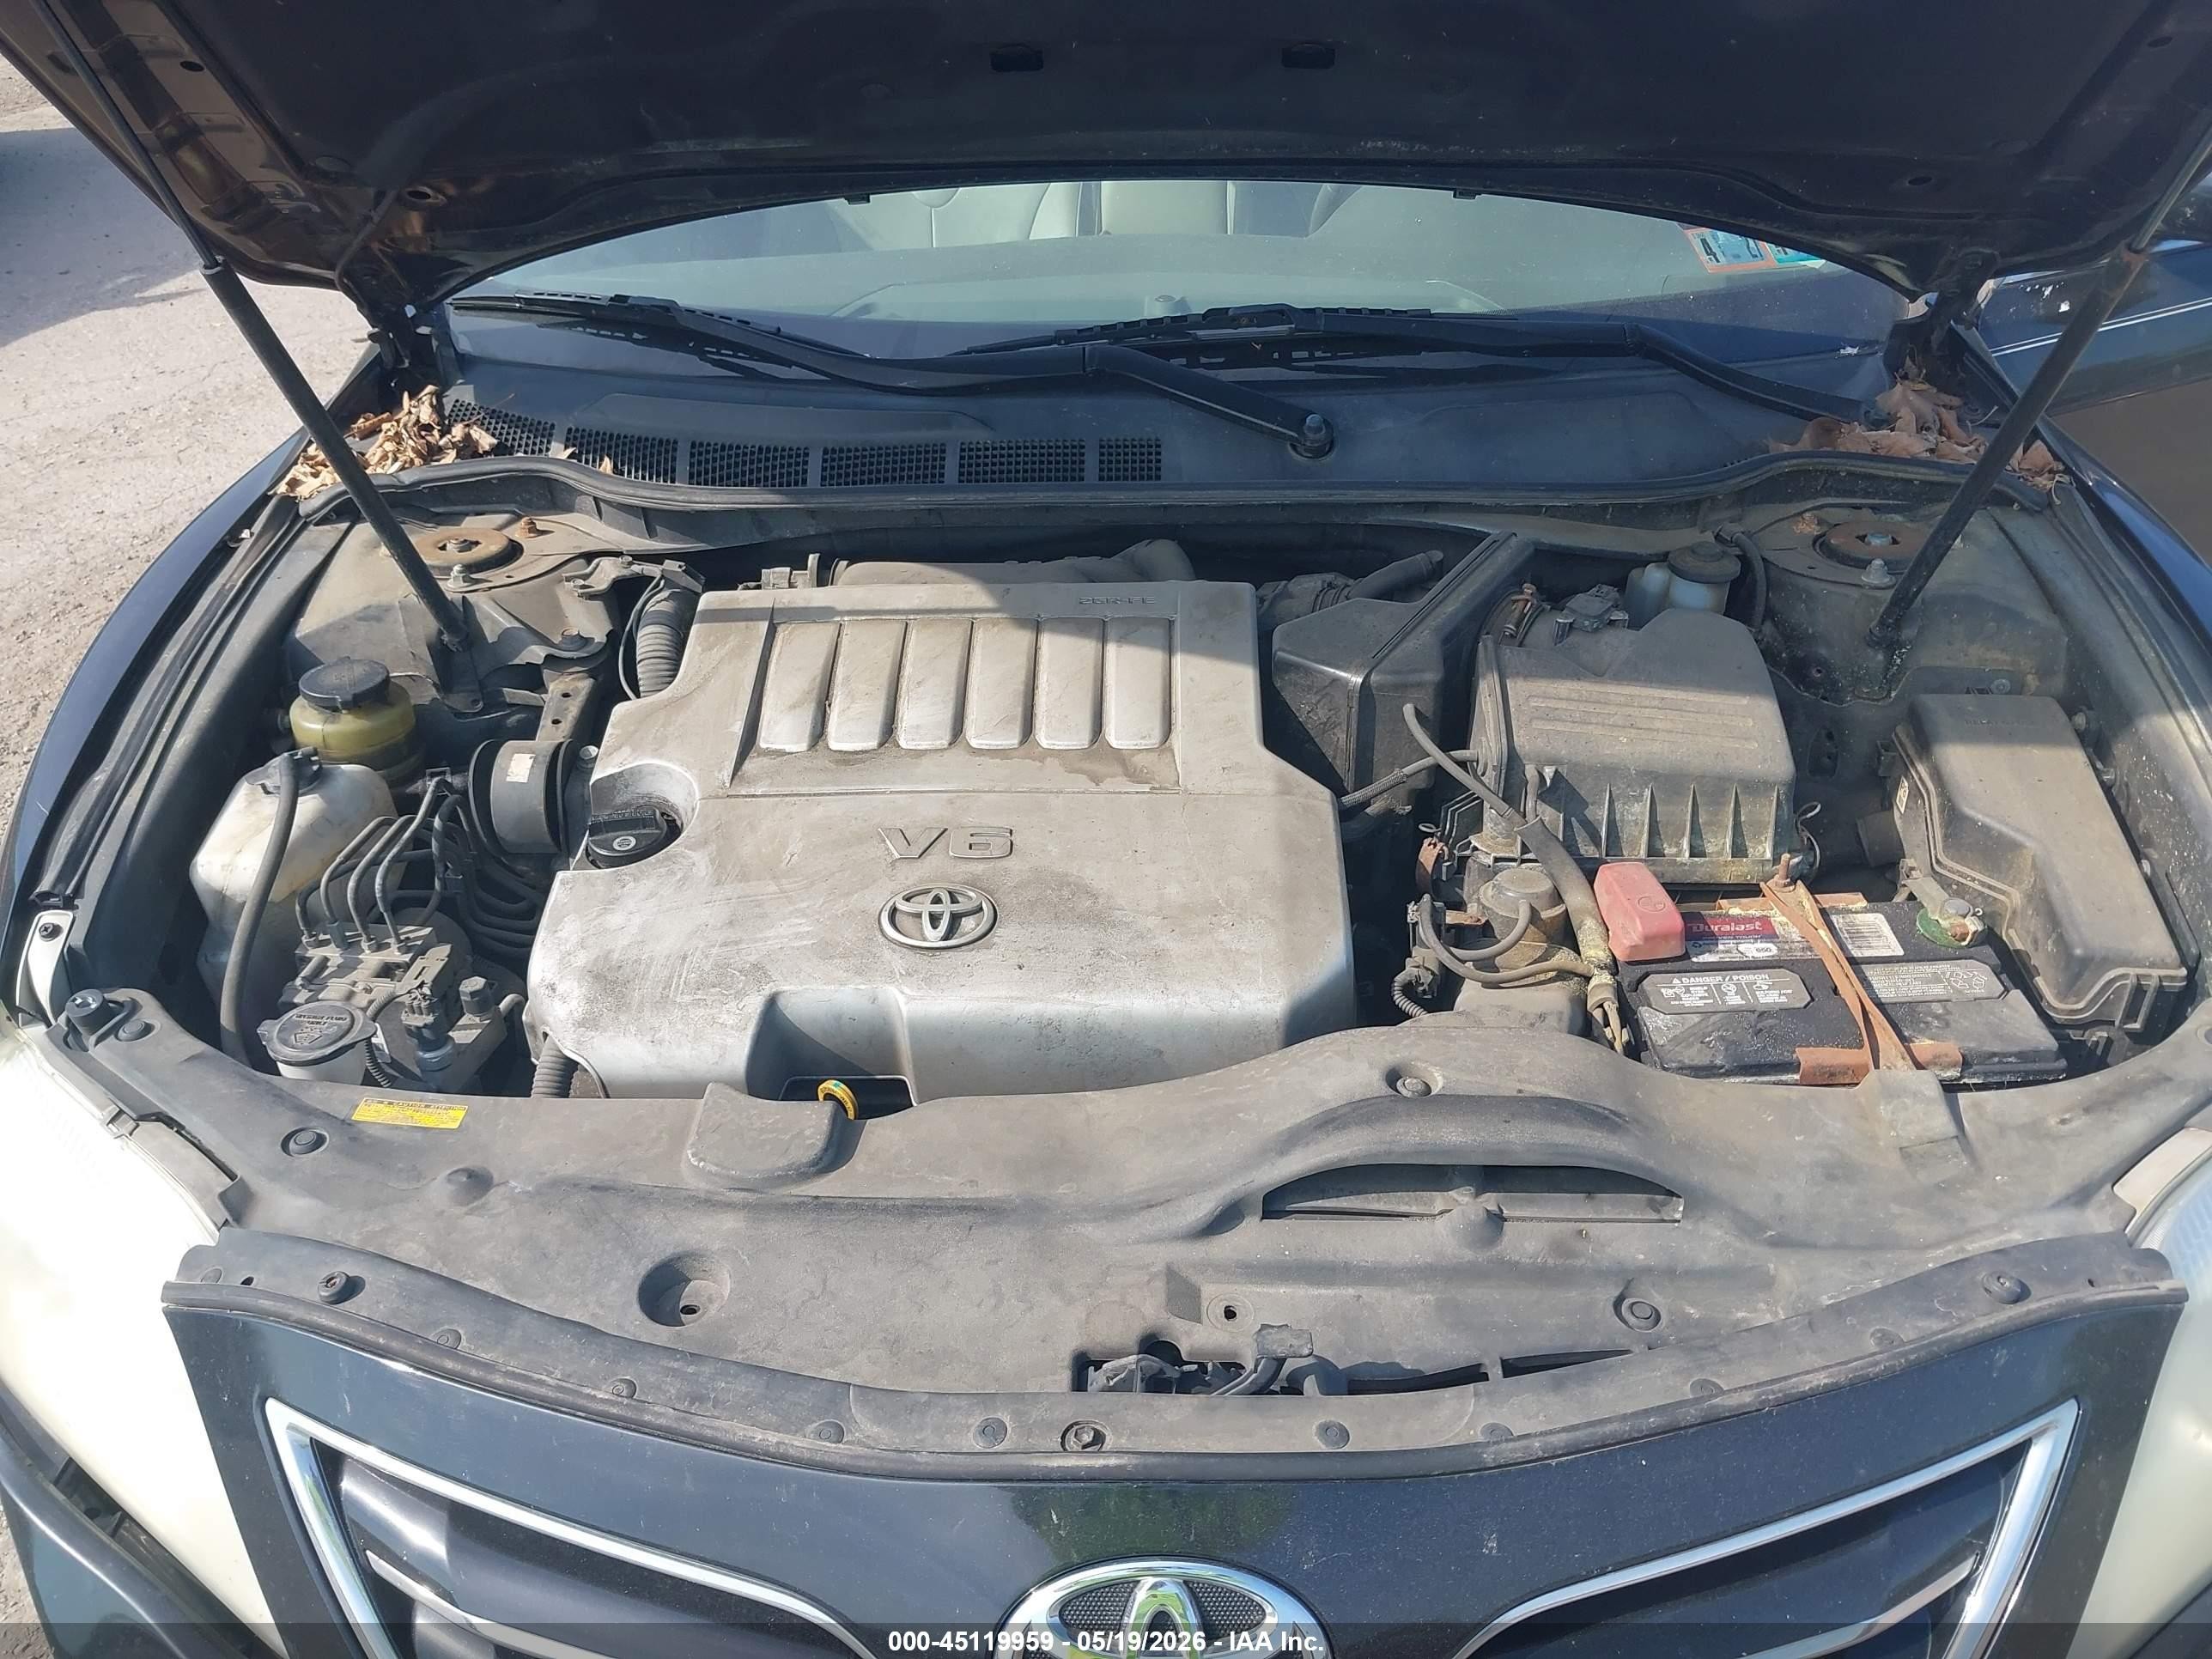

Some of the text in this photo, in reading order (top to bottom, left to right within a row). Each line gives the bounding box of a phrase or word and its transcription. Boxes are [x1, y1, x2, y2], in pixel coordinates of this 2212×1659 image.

[1078, 596, 1156, 605] 2GR-FE
[877, 826, 1015, 860] V6
[1687, 920, 1763, 933] Duralast
[1681, 975, 1723, 984] DANGER
